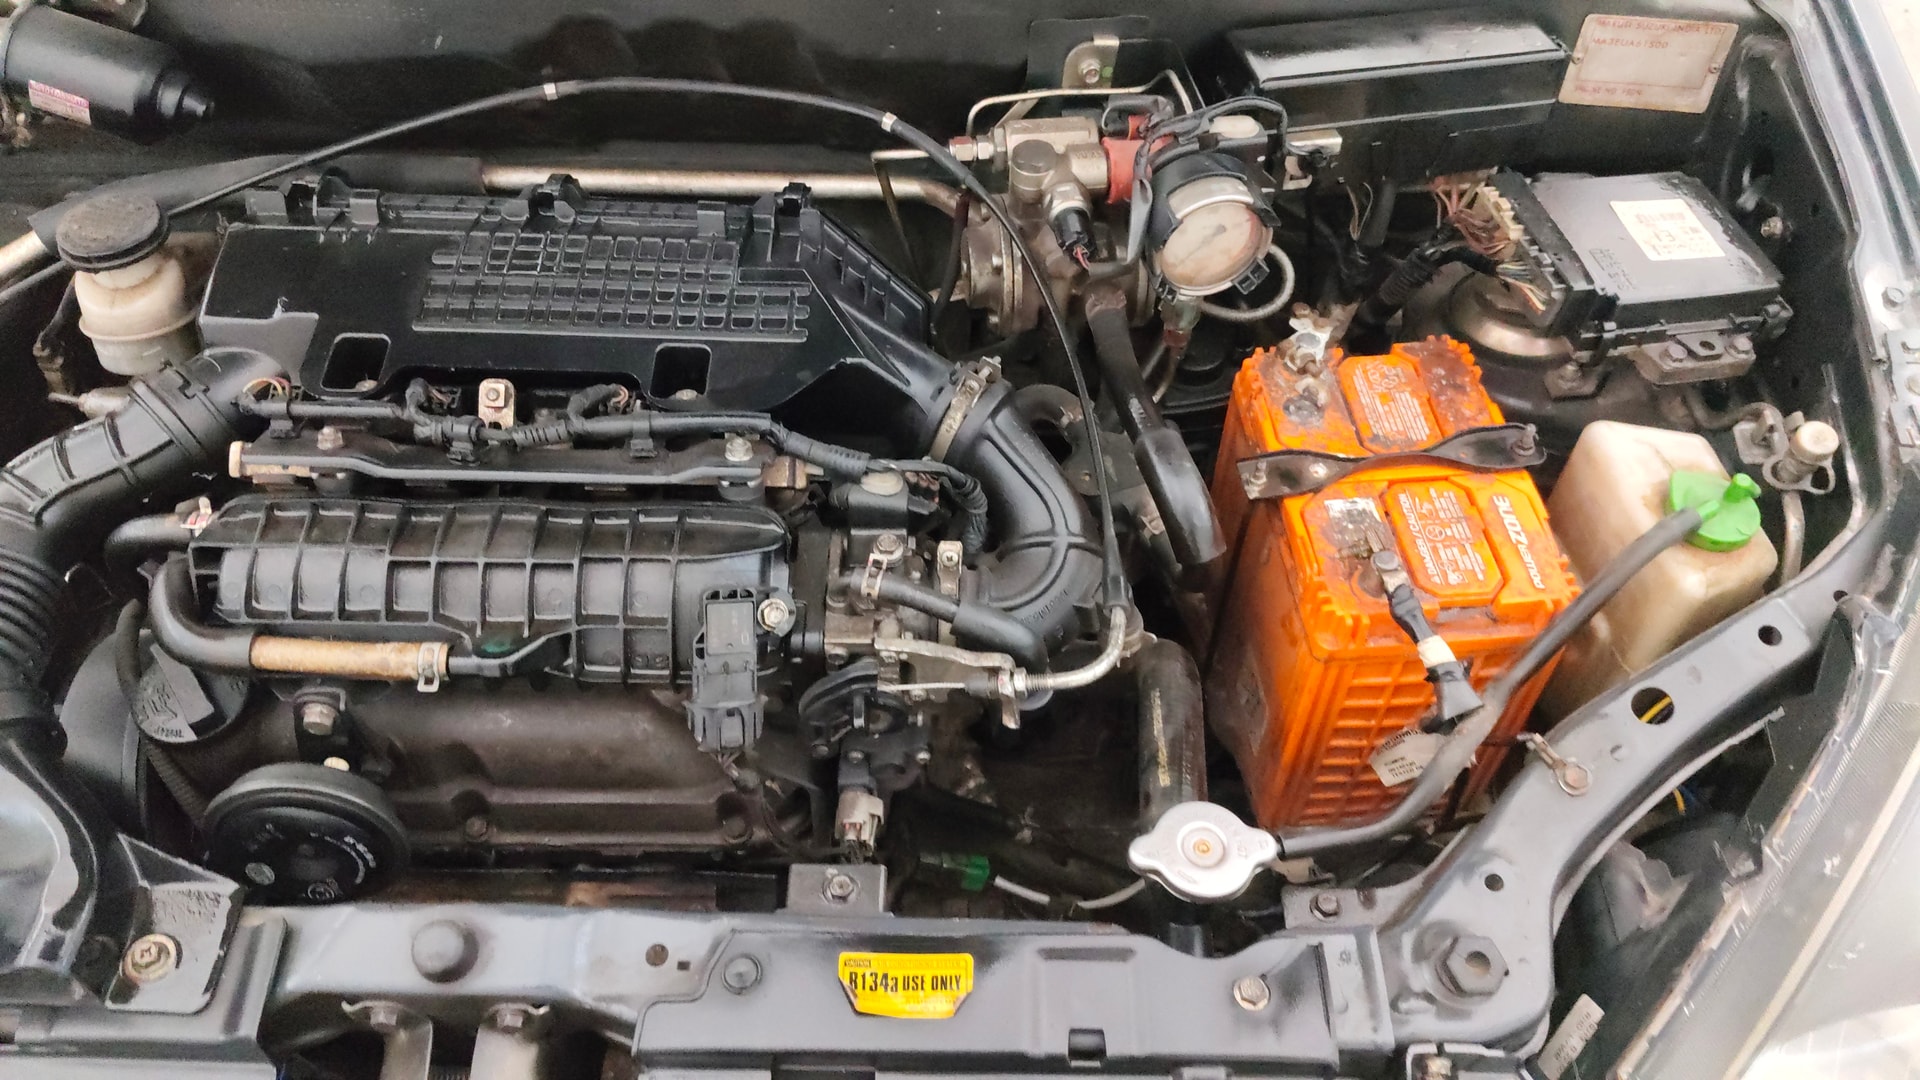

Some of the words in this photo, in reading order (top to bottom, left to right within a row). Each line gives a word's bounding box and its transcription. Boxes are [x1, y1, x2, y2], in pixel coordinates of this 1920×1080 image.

[849, 971, 898, 992] R134a
[902, 975, 925, 991] USE
[931, 975, 961, 991] ONLY
